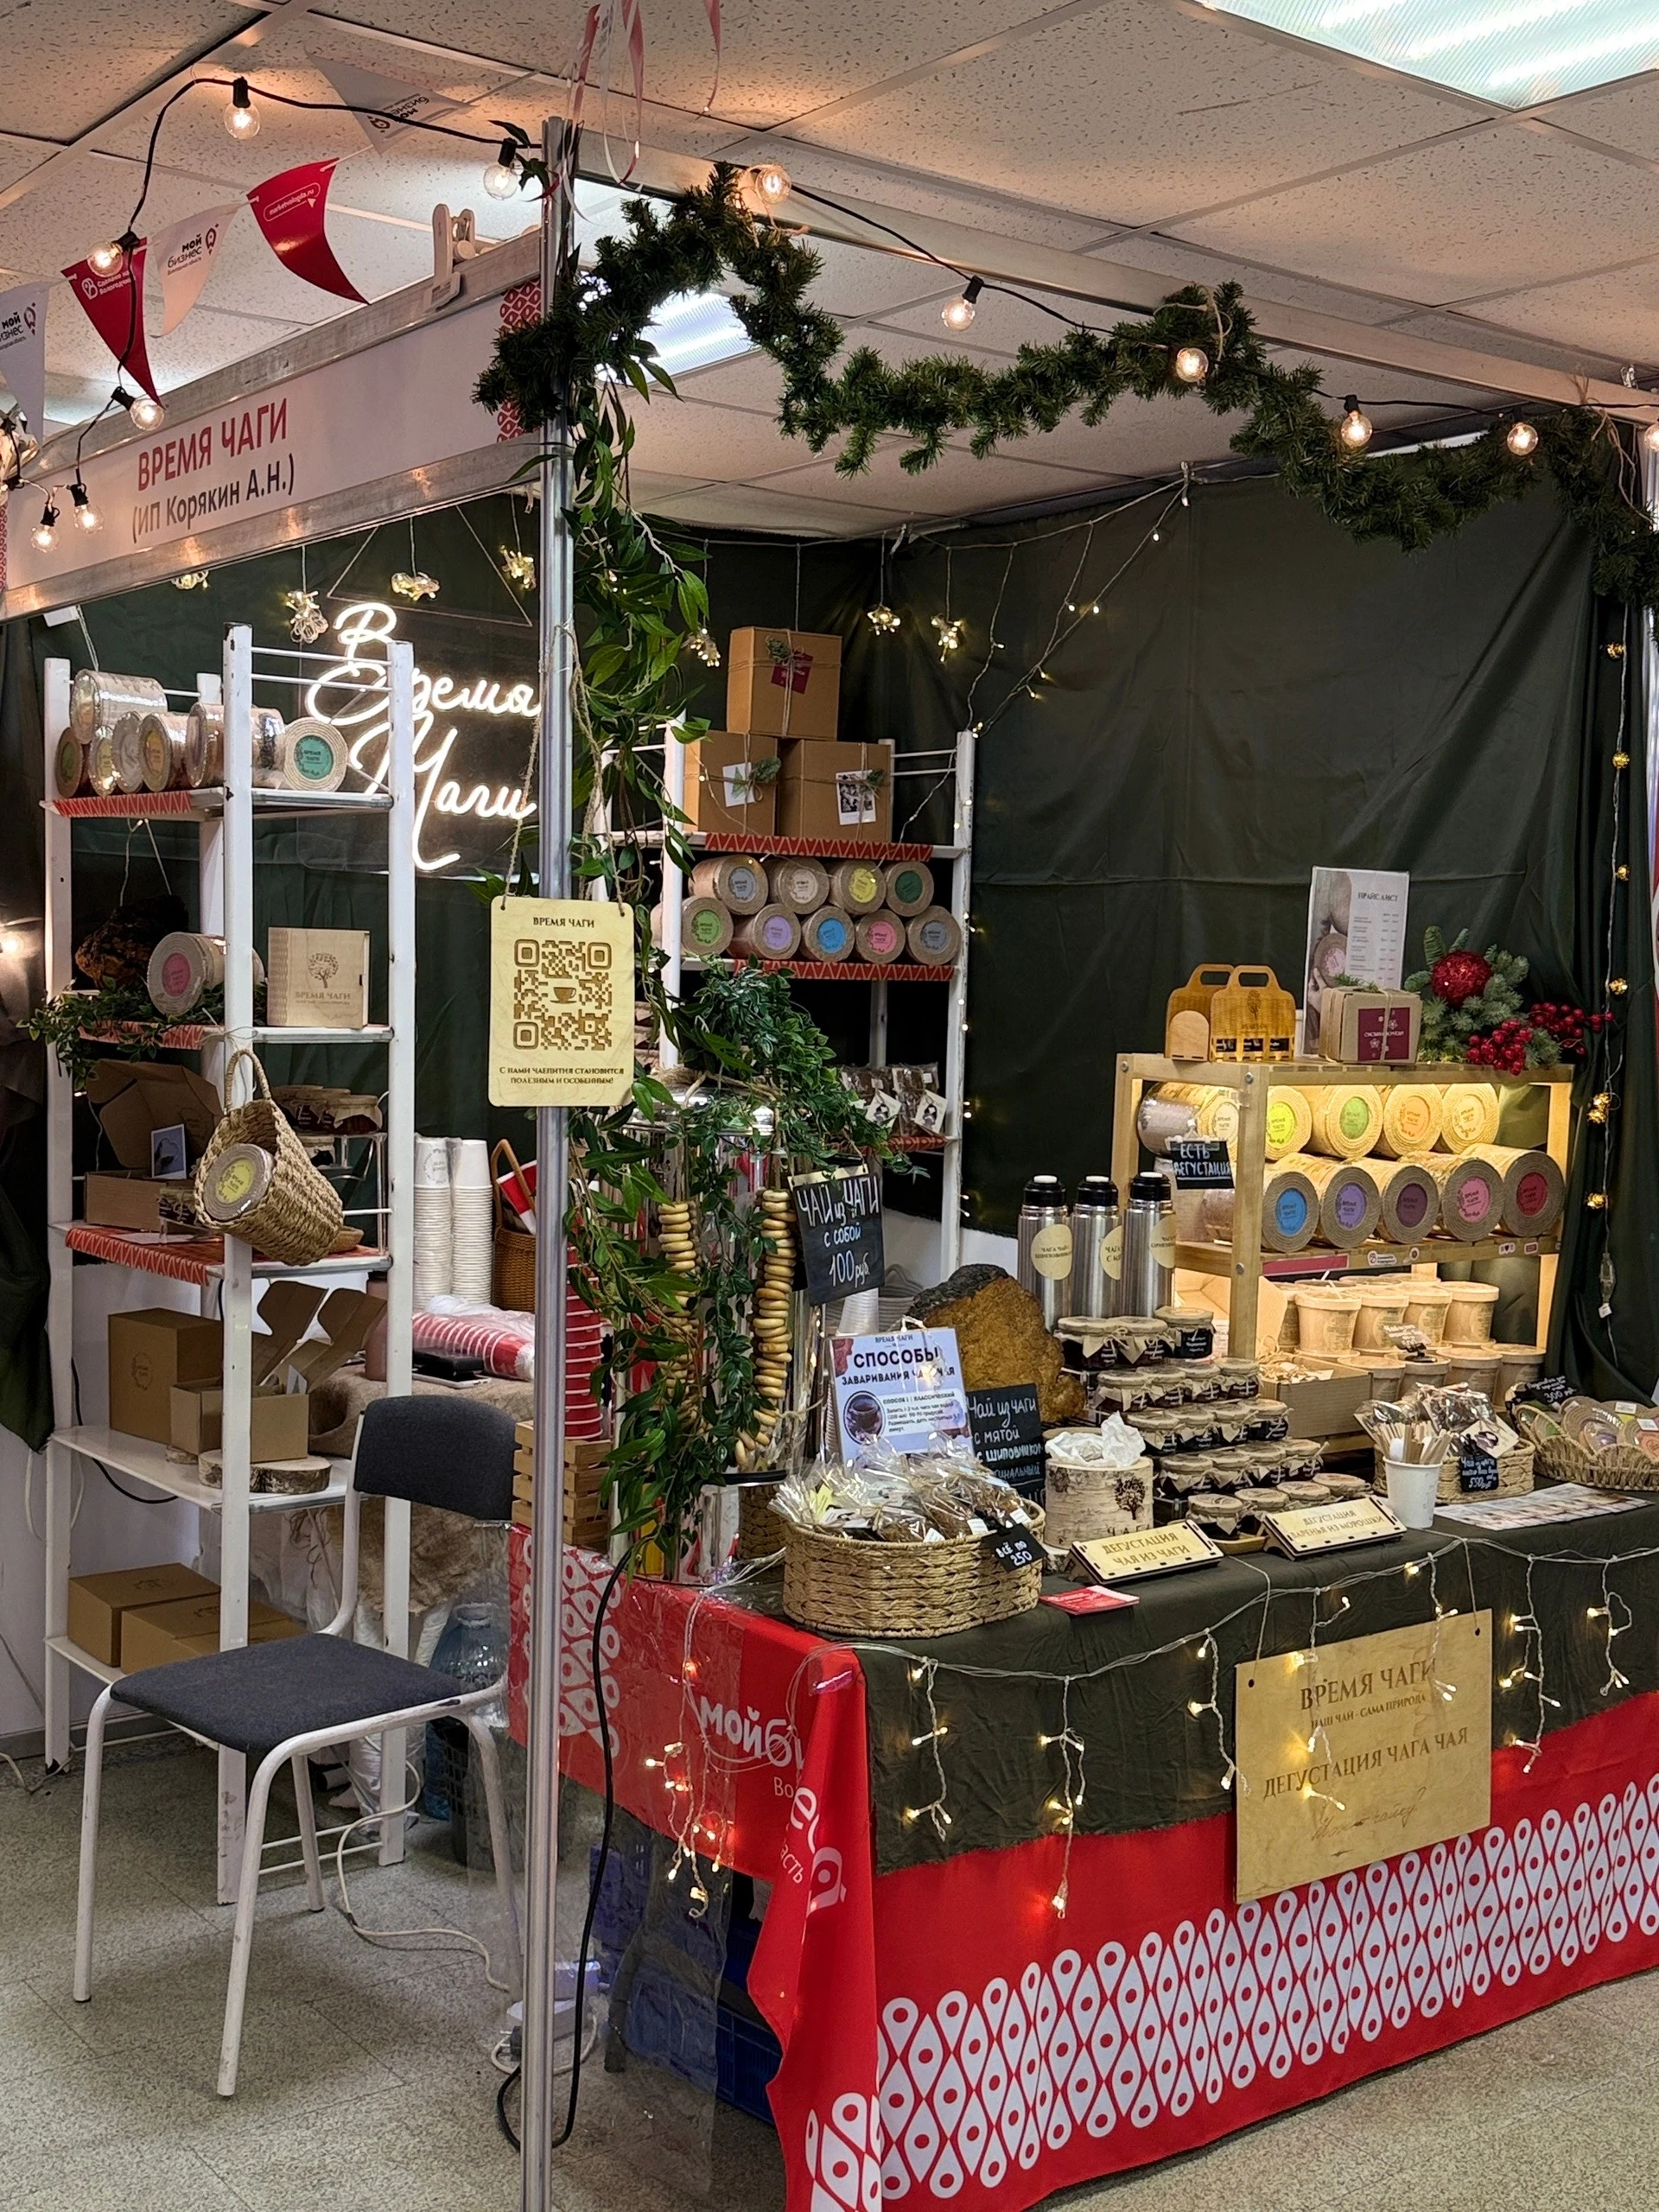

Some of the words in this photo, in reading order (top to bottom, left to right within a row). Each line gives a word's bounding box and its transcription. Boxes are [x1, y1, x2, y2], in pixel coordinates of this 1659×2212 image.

[390, 96, 430, 116] бизне
[181, 233, 202, 253] мой
[168, 246, 202, 268] бизнес
[1, 311, 21, 330] мой
[0, 325, 24, 342] знес
[137, 426, 213, 492] ВРЕМЯ
[221, 397, 288, 458] ЧАГИ
[132, 500, 161, 544] (ИП
[166, 480, 240, 531] Корякин
[245, 452, 295, 502] А.Н.)
[532, 917, 566, 927] ВРЕМЯ
[569, 918, 594, 929] ЧАГИ
[1180, 1143, 1211, 1160] ЕСТЬ
[796, 1183, 834, 1227] ЧАЙ
[834, 1200, 847, 1226] из
[842, 1175, 880, 1217] ЧАГИ
[853, 1346, 939, 1369] СПОСОБЫ
[842, 1370, 910, 1386] ЗАВАРИВАНИЯ
[968, 1395, 995, 1419] Чай
[997, 1401, 1011, 1428] из
[1302, 1510, 1357, 1526] ДЕГУСТАЦИЯ
[1328, 1523, 1340, 1534] ИЗ
[1339, 1516, 1385, 1531] МОРОШКИ
[1102, 1532, 1179, 1554] ДЕГУСТАЦИЯ
[1010, 1550, 1033, 1567] 250
[1113, 1553, 1141, 1567] ЧАЯ
[1141, 1551, 1156, 1562] ИЗ
[1156, 1544, 1191, 1558] ЧАГИ
[1300, 1673, 1374, 1711] ВРЕМЯ
[1380, 1657, 1438, 1689] ЧАГИ
[1359, 1705, 1384, 1718] САМА
[1385, 1694, 1426, 1711] ПРИРОДА
[1262, 1750, 1382, 1802] ДЕГУСТАЦИЯ
[1387, 1738, 1431, 1764] ЧАГА
[1433, 1726, 1469, 1751] ЧАЯ
